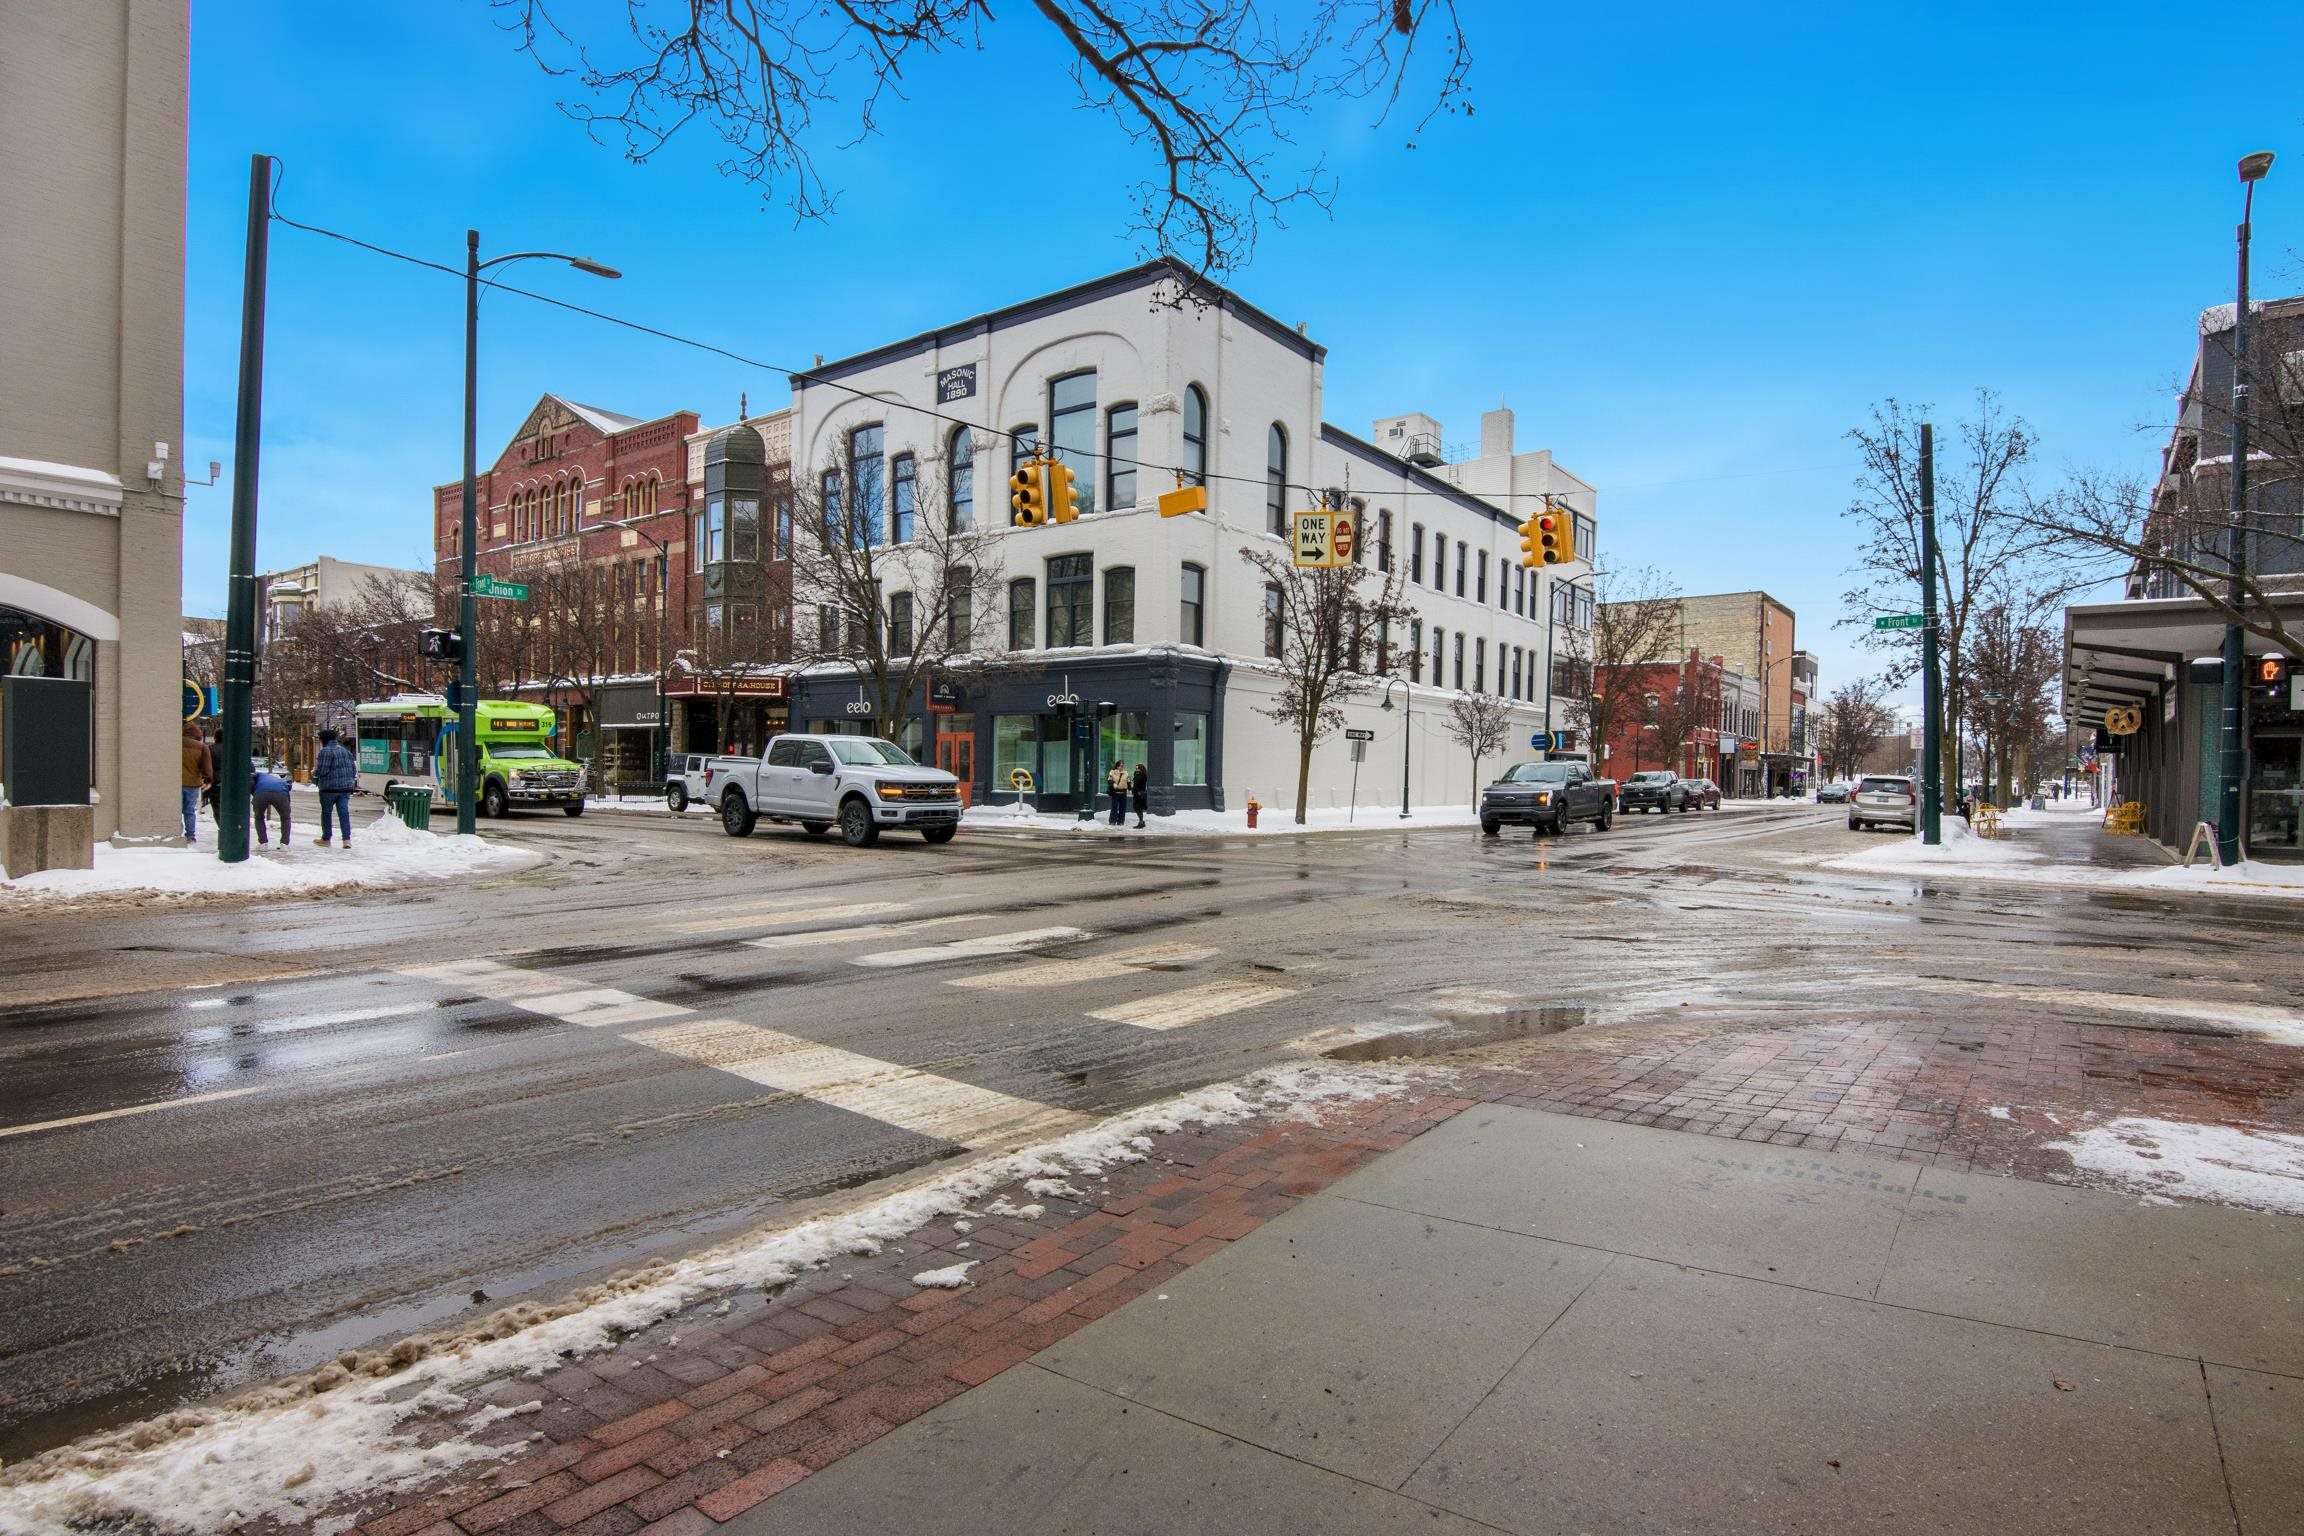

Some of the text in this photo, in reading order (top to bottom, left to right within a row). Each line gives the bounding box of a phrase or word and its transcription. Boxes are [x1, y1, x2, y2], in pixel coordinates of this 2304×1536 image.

[940, 368, 974, 387] MASONIC
[947, 379, 965, 390] HALL
[946, 387, 967, 400] 1890
[1302, 518, 1325, 530] ONE
[1301, 532, 1326, 544] WAY
[1887, 616, 1909, 628] Front
[846, 685, 872, 713] eelo
